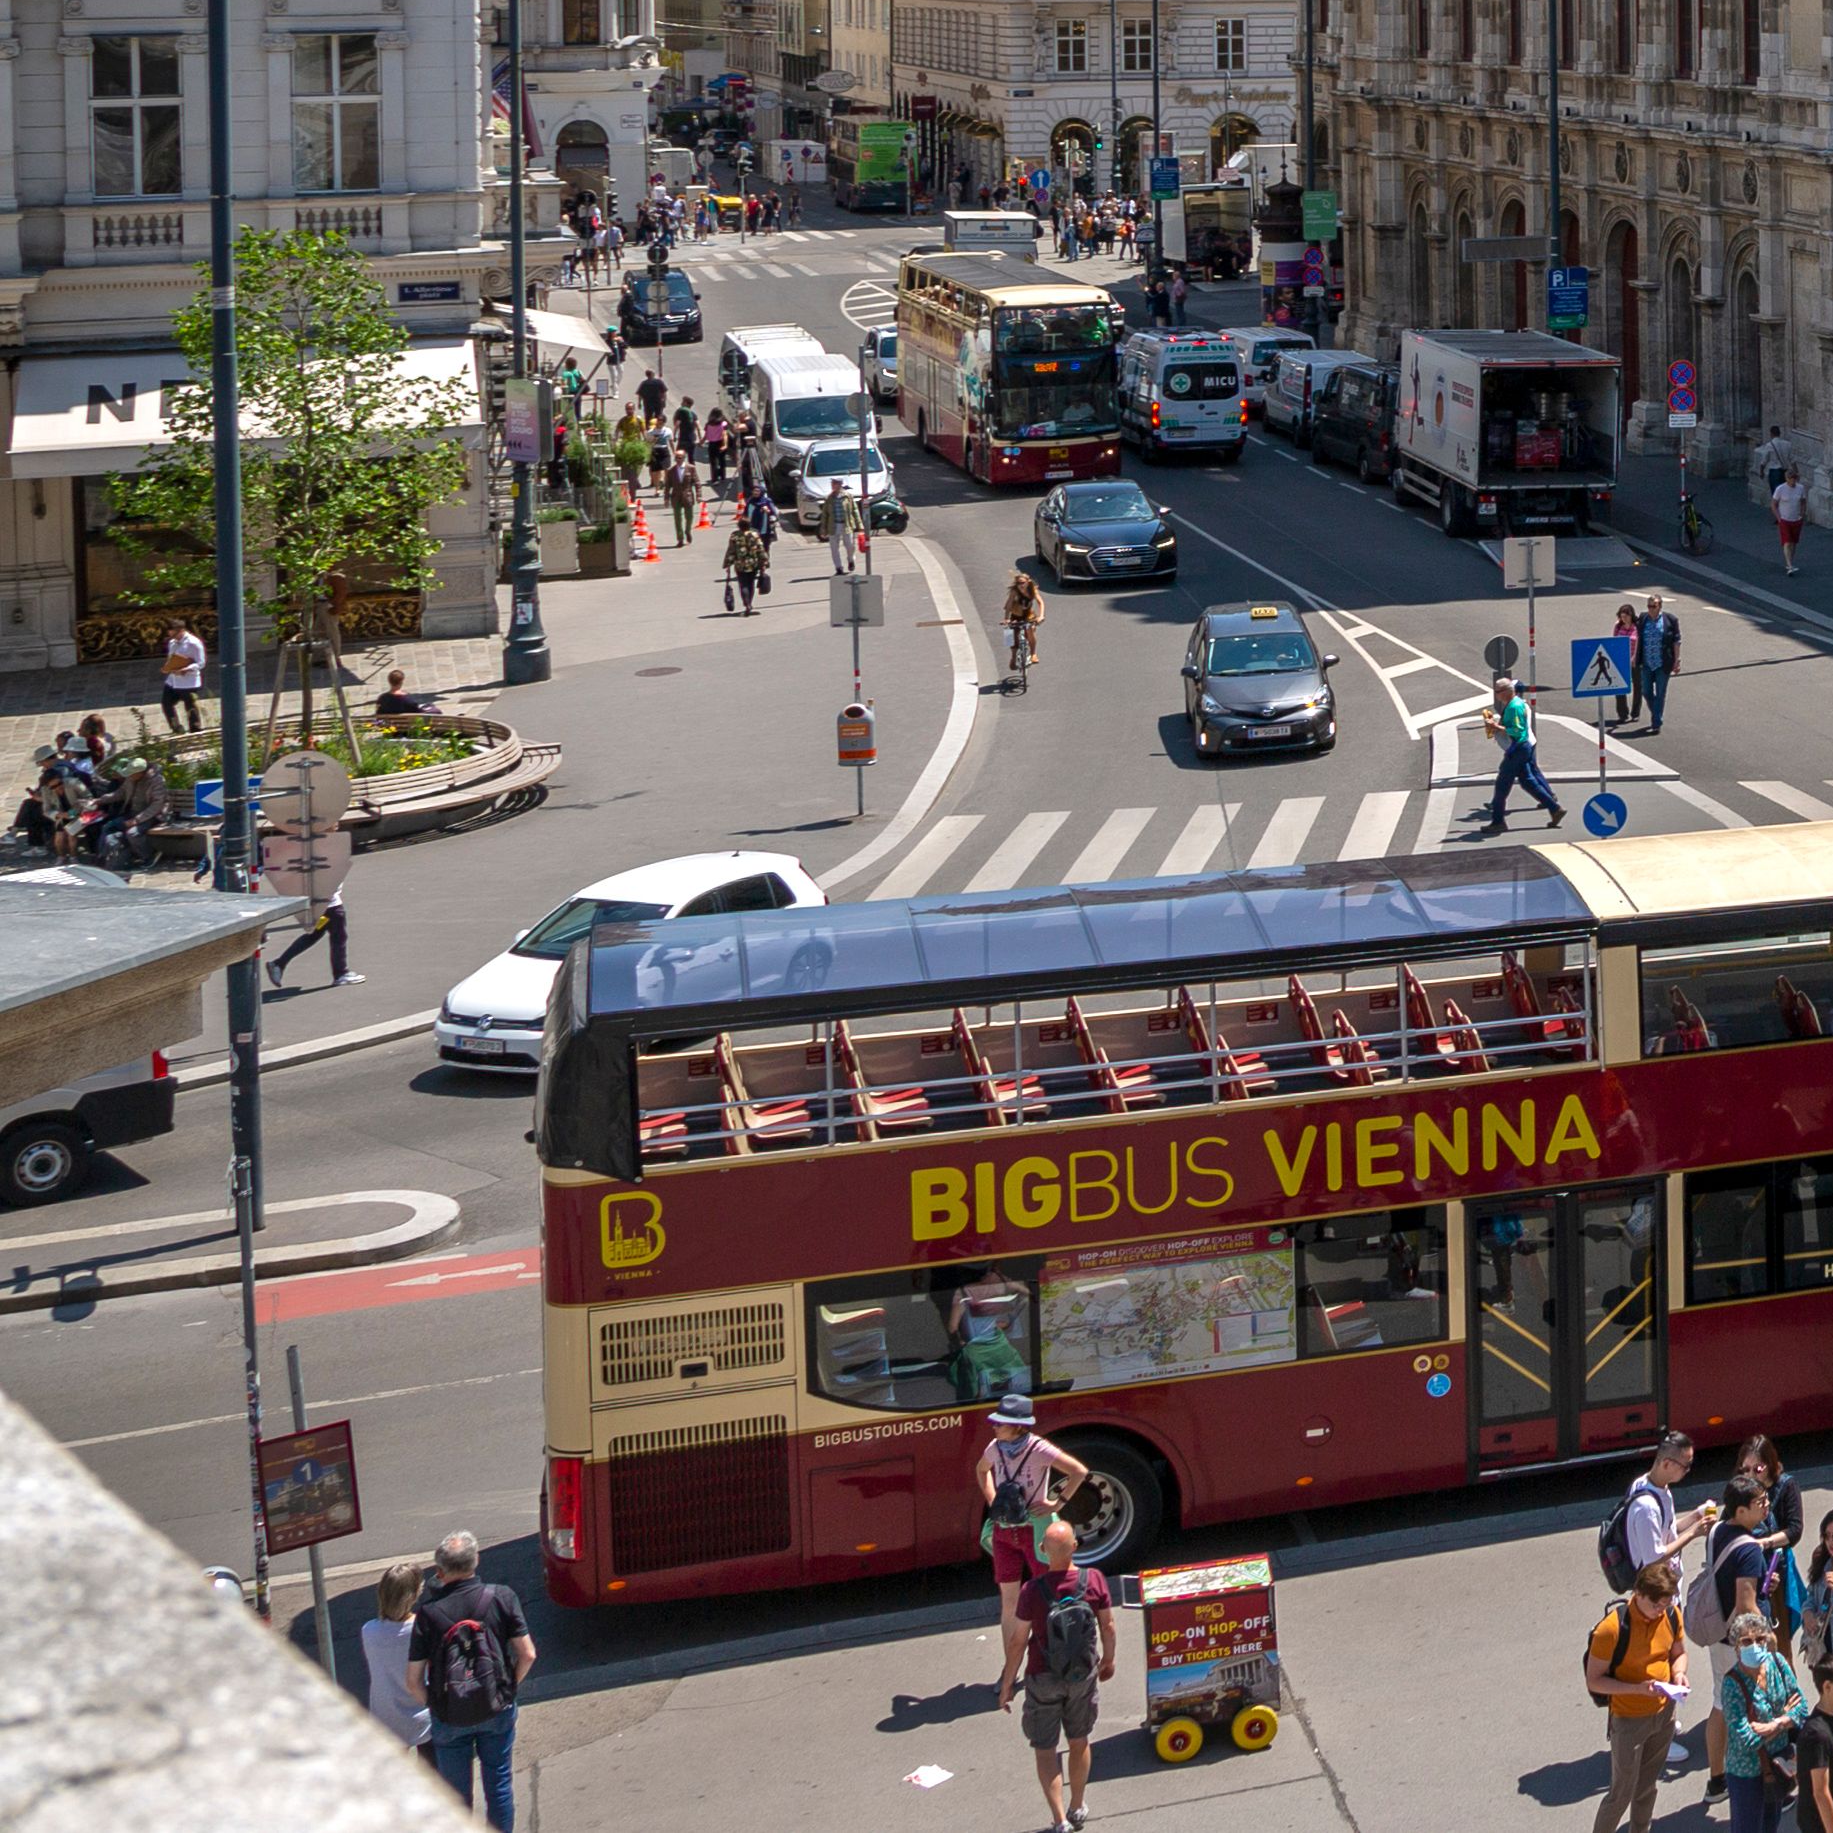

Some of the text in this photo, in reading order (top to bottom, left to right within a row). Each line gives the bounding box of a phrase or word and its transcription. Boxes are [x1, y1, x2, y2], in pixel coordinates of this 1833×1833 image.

[1552, 274, 1564, 287] P
[1203, 375, 1236, 388] MICU
[911, 1094, 1602, 1242] BIGBUS VIENNA
[1118, 1243, 1166, 1256] DISCOVER
[1167, 1237, 1211, 1251] HOP-OFF
[1212, 1232, 1255, 1247] EXPLORE
[614, 1269, 653, 1280] VIENNA
[814, 1414, 963, 1449] BIGBUSTOURS.COM
[301, 1462, 312, 1481] 1
[1152, 1615, 1272, 1645] HOP-ON HOP-OFF
[1162, 1654, 1184, 1667] BUY
[1186, 1646, 1231, 1663] TICKETS
[1233, 1641, 1263, 1654] HERE
